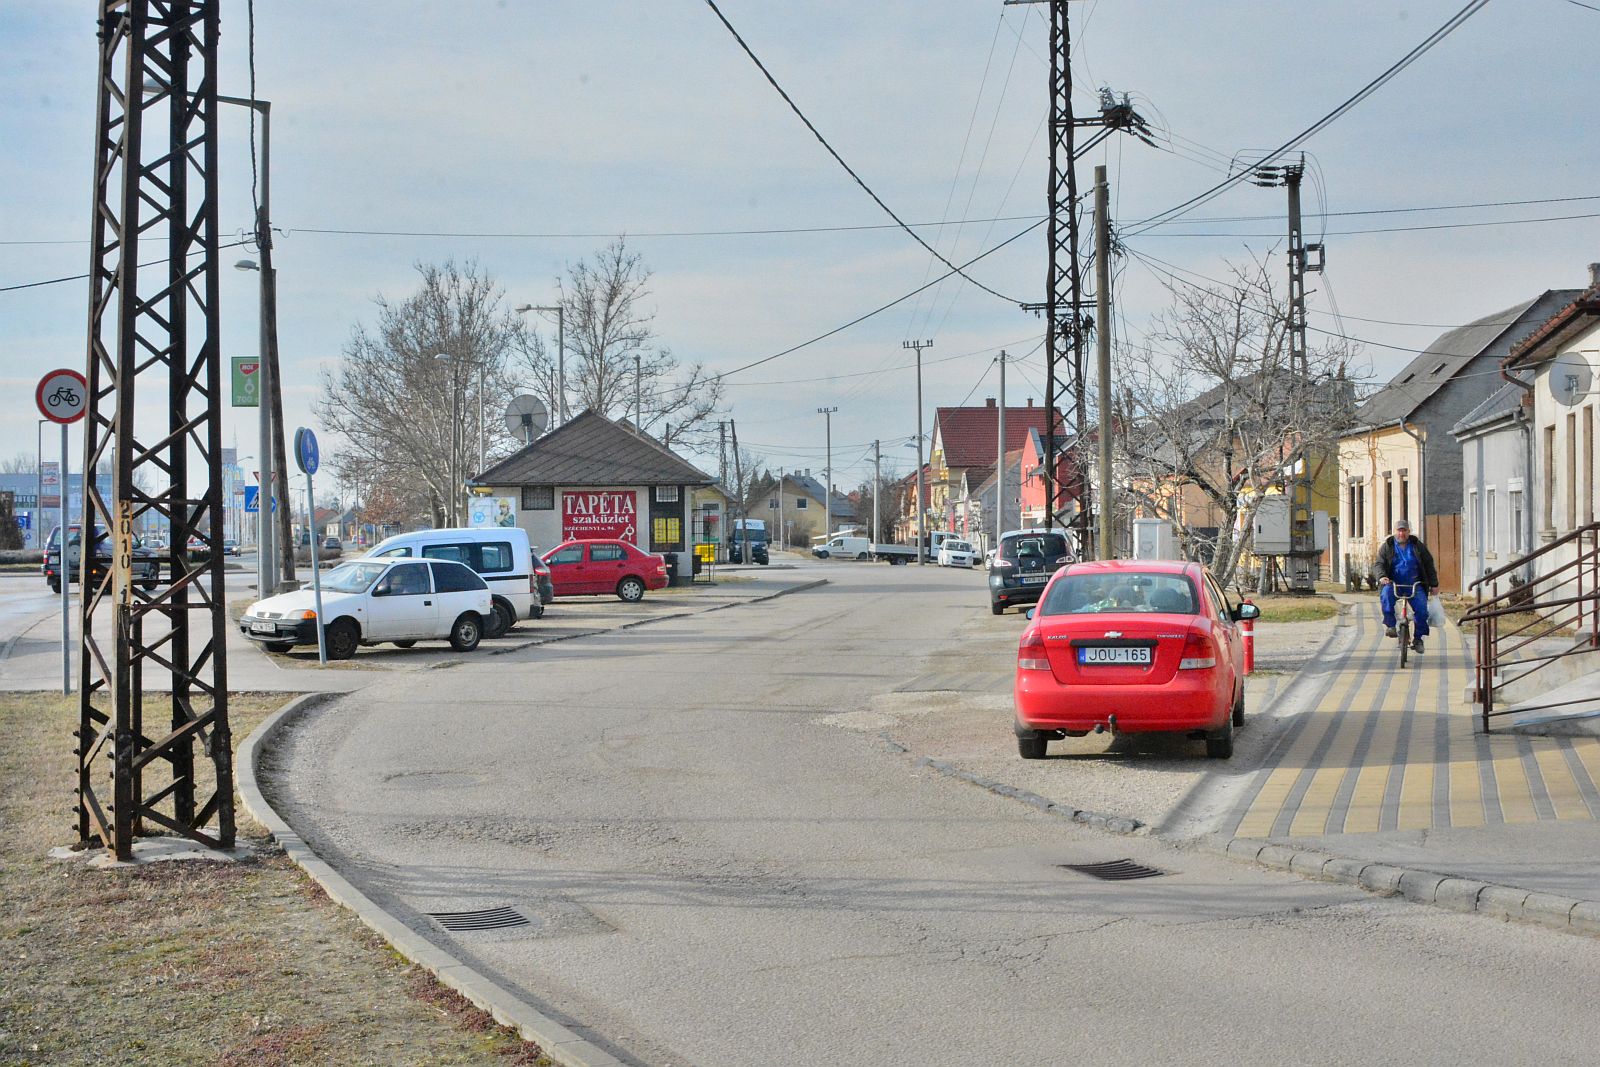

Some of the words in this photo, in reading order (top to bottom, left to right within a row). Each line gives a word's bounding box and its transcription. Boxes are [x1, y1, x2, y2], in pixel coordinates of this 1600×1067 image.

[564, 492, 635, 515] TAPÉTA
[573, 515, 629, 524] szaküzlet
[1088, 648, 1147, 661] JOU-165
